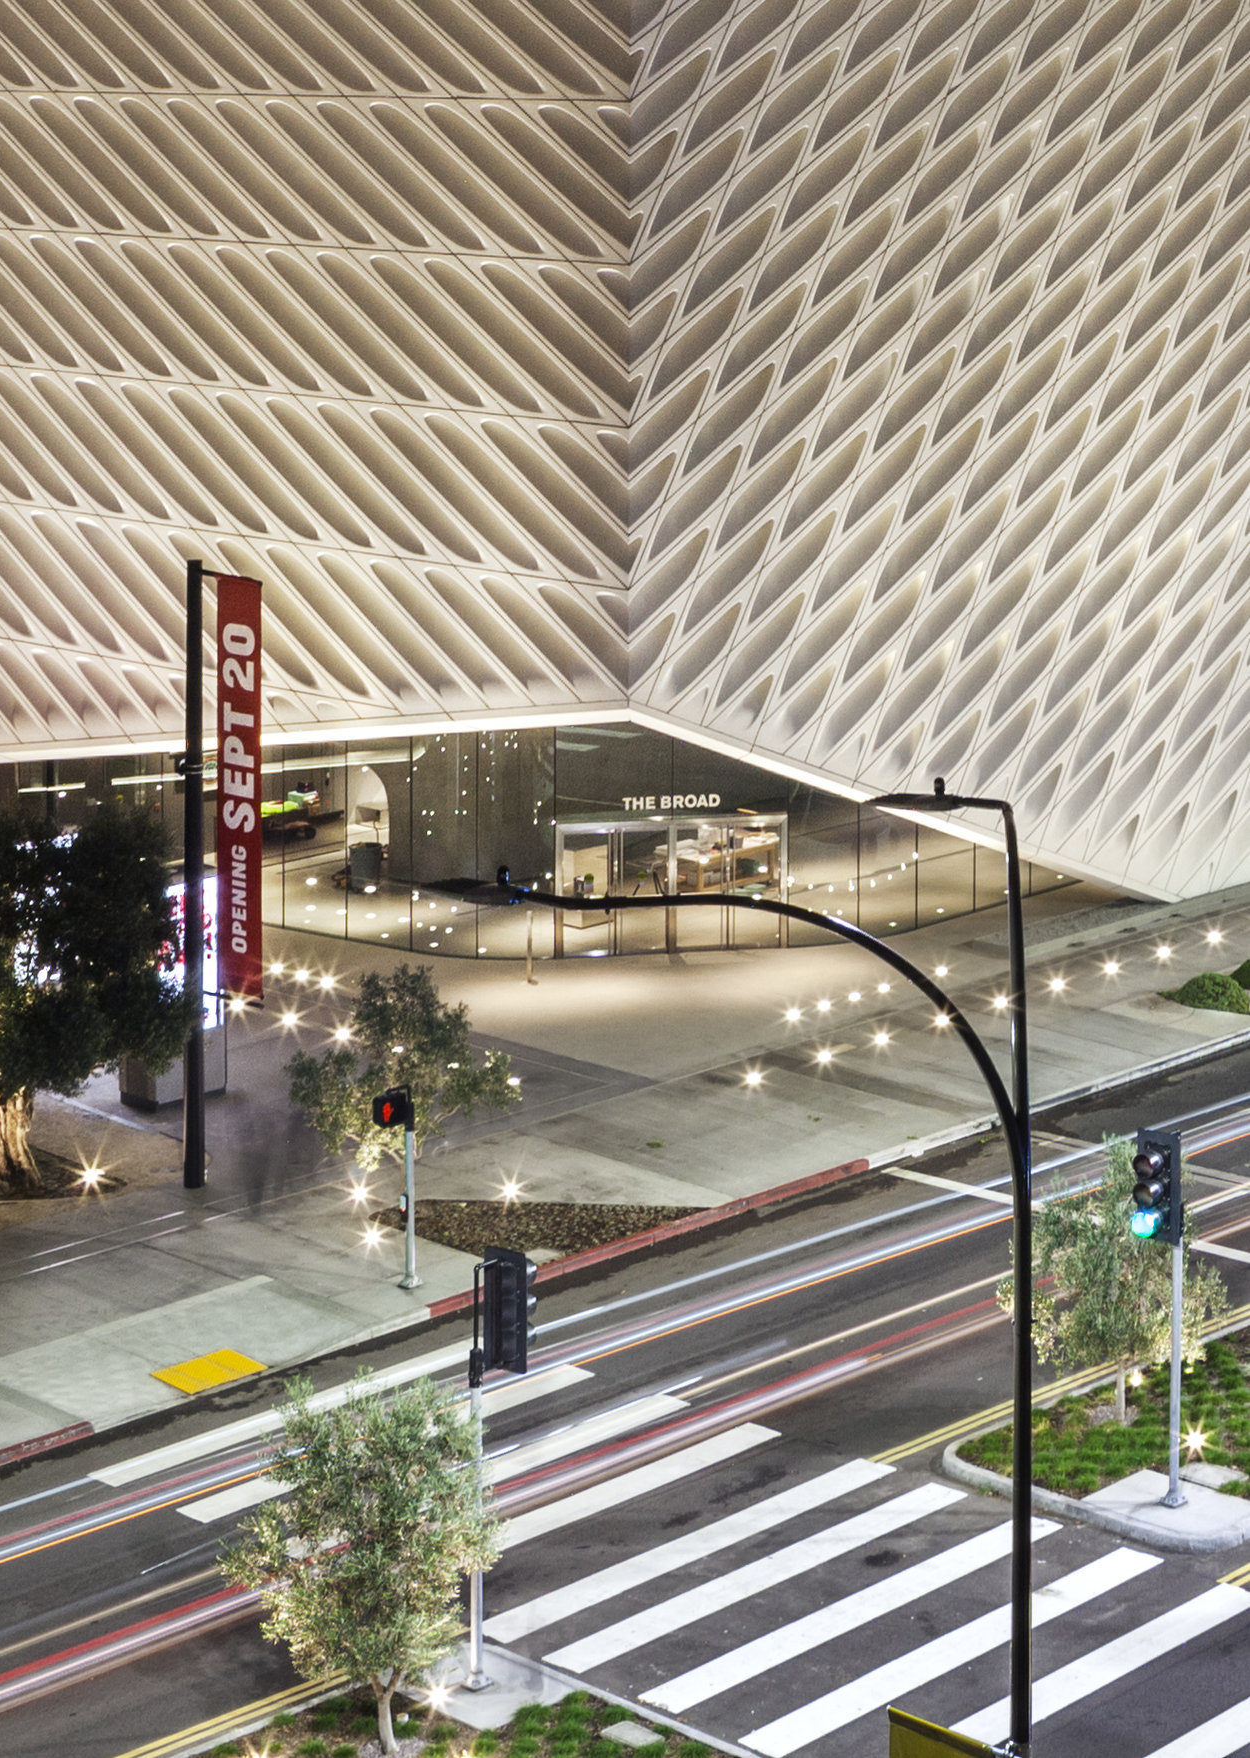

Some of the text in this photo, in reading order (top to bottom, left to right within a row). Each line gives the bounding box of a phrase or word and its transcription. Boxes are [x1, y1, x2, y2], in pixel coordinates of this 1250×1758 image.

[222, 622, 256, 954] OPENING SEPT 20
[622, 793, 721, 811] THE BROAD
